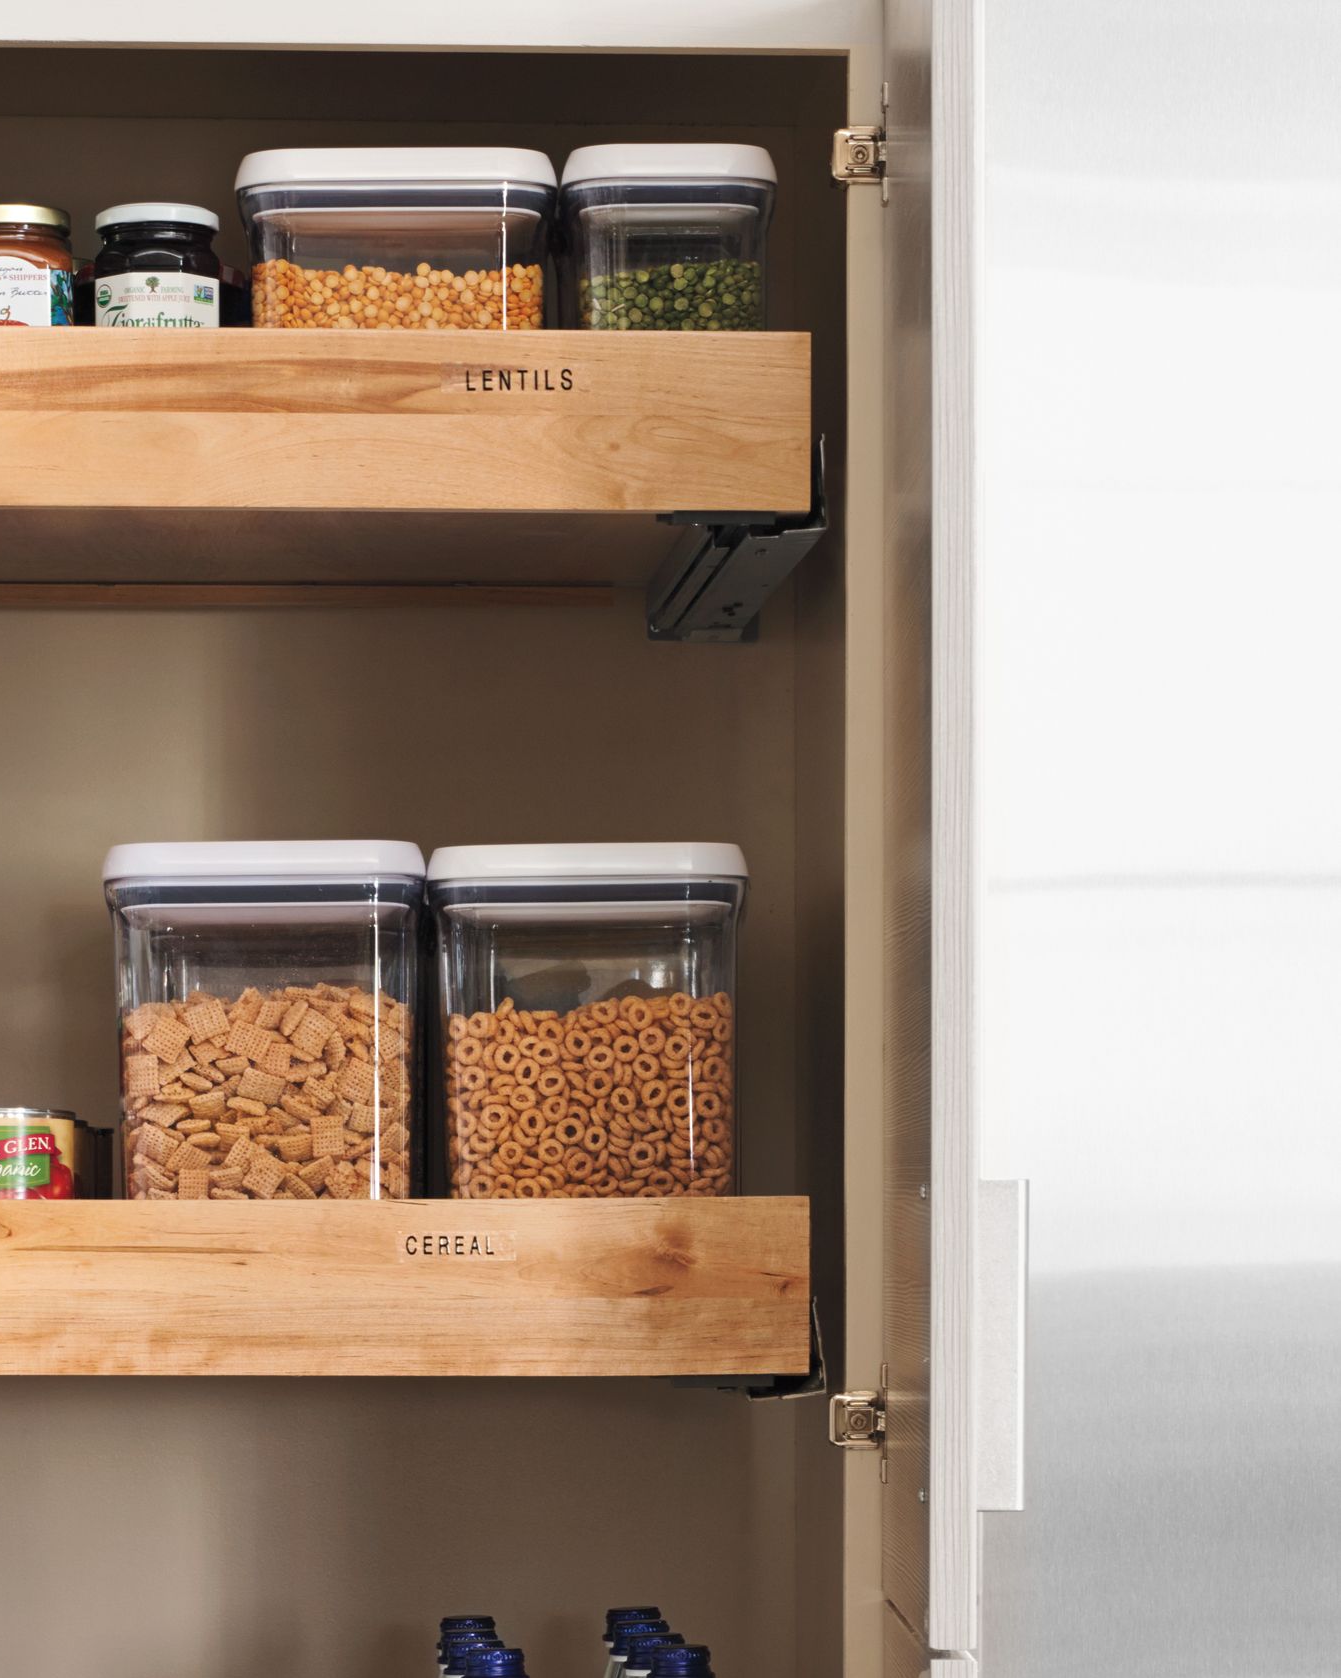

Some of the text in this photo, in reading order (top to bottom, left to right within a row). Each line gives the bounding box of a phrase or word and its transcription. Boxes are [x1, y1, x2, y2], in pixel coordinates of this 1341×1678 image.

[466, 368, 573, 392] LENTILS
[4, 1136, 50, 1154] GLEN
[405, 1235, 495, 1256] CEREAL
